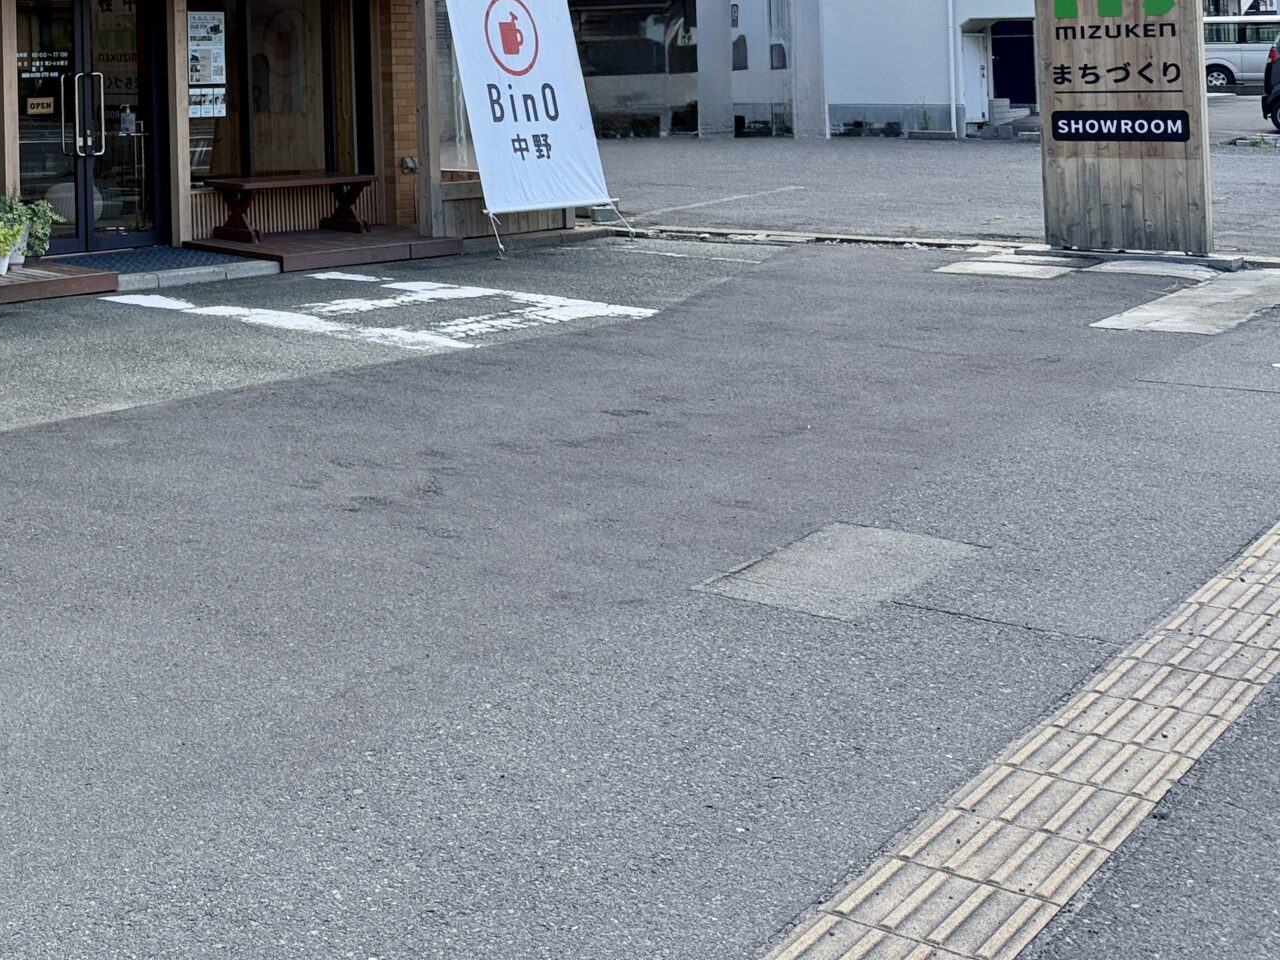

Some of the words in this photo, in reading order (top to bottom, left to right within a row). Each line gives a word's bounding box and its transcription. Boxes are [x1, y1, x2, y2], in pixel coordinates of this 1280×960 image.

[1052, 61, 1181, 86] まちづくり
[29, 102, 52, 110] OPEN
[1057, 119, 1183, 135] SHOWROOM
[511, 133, 552, 161] 中野
